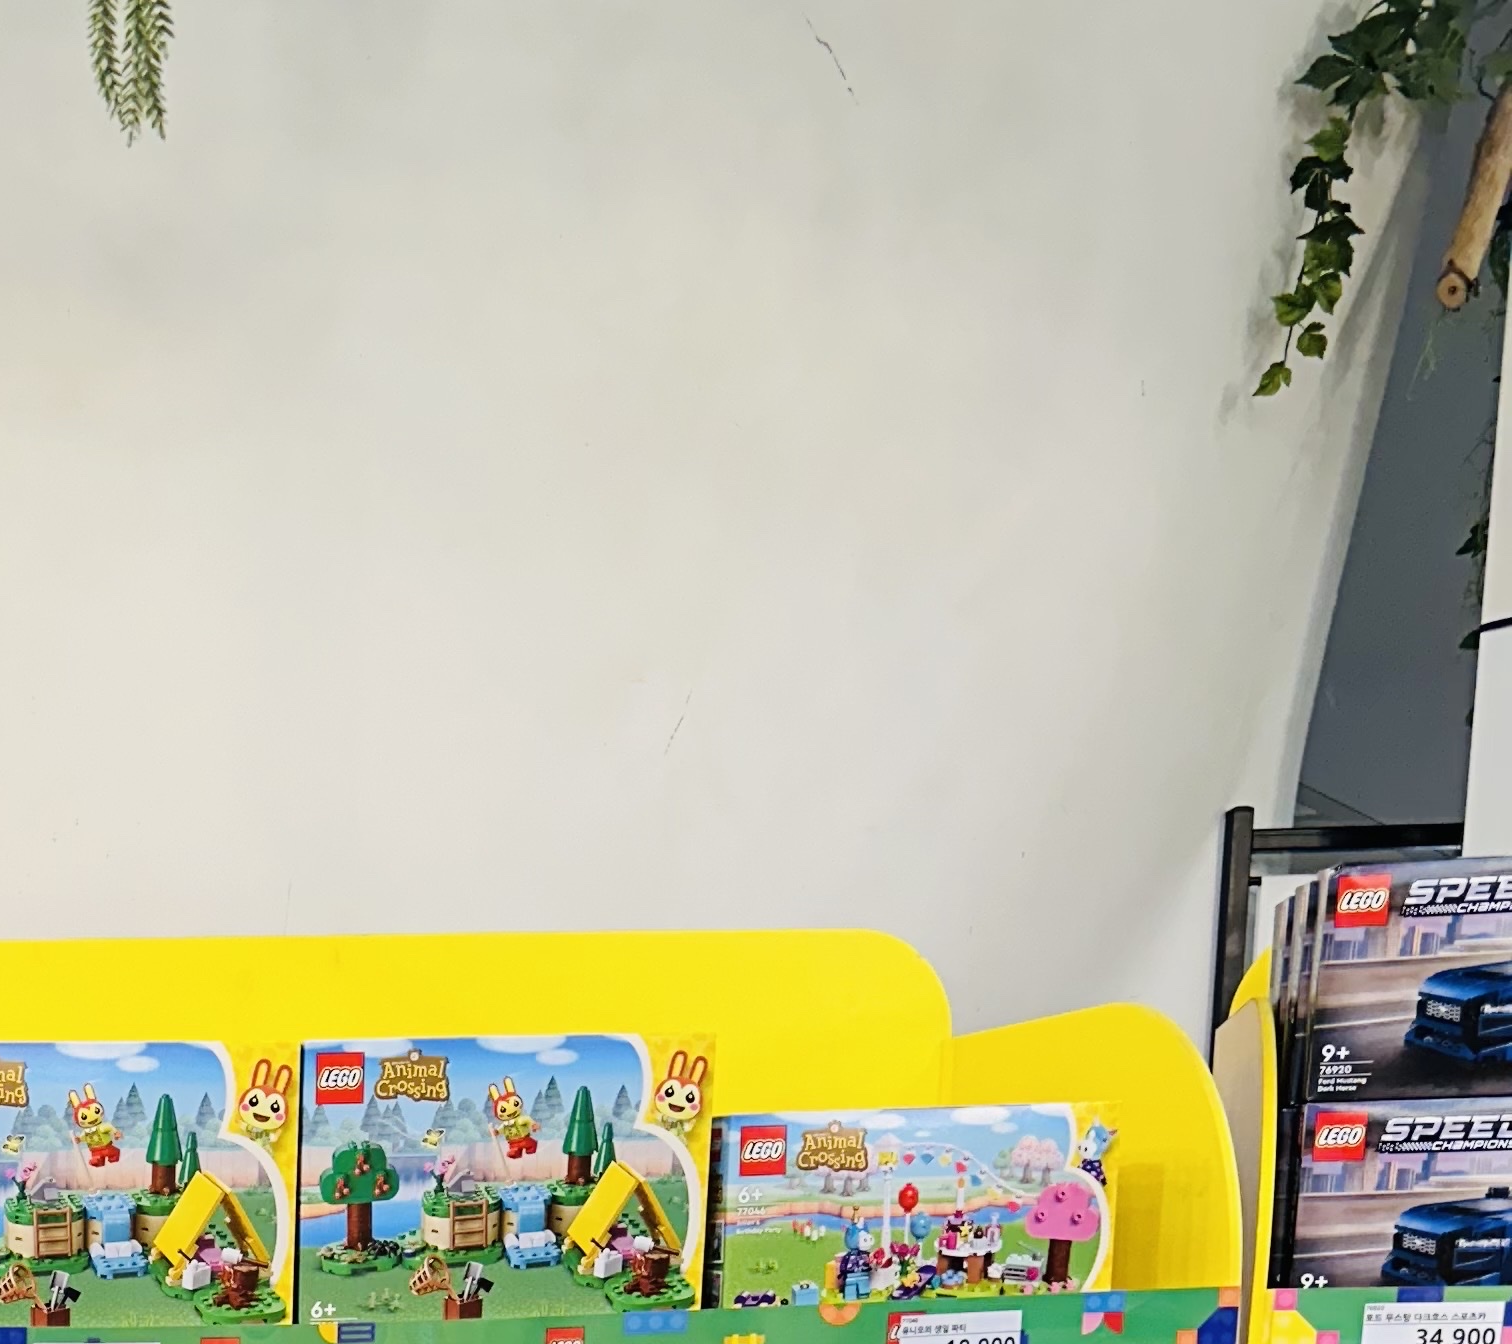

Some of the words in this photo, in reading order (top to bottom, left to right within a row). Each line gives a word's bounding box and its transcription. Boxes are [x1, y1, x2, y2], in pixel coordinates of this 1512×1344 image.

[1322, 1044, 1350, 1062] 9+
[320, 1066, 361, 1088] LEGO
[383, 1061, 447, 1082] Animal
[1320, 1065, 1351, 1074] 76920
[376, 1077, 448, 1099] Crossing
[805, 1132, 863, 1150] Animal
[1317, 1126, 1365, 1145] LEGO
[743, 1140, 784, 1160] LEGO
[798, 1150, 865, 1169] Crossing
[738, 1187, 762, 1203] 6+
[1301, 1274, 1328, 1288] 9+
[311, 1302, 336, 1319] 6+
